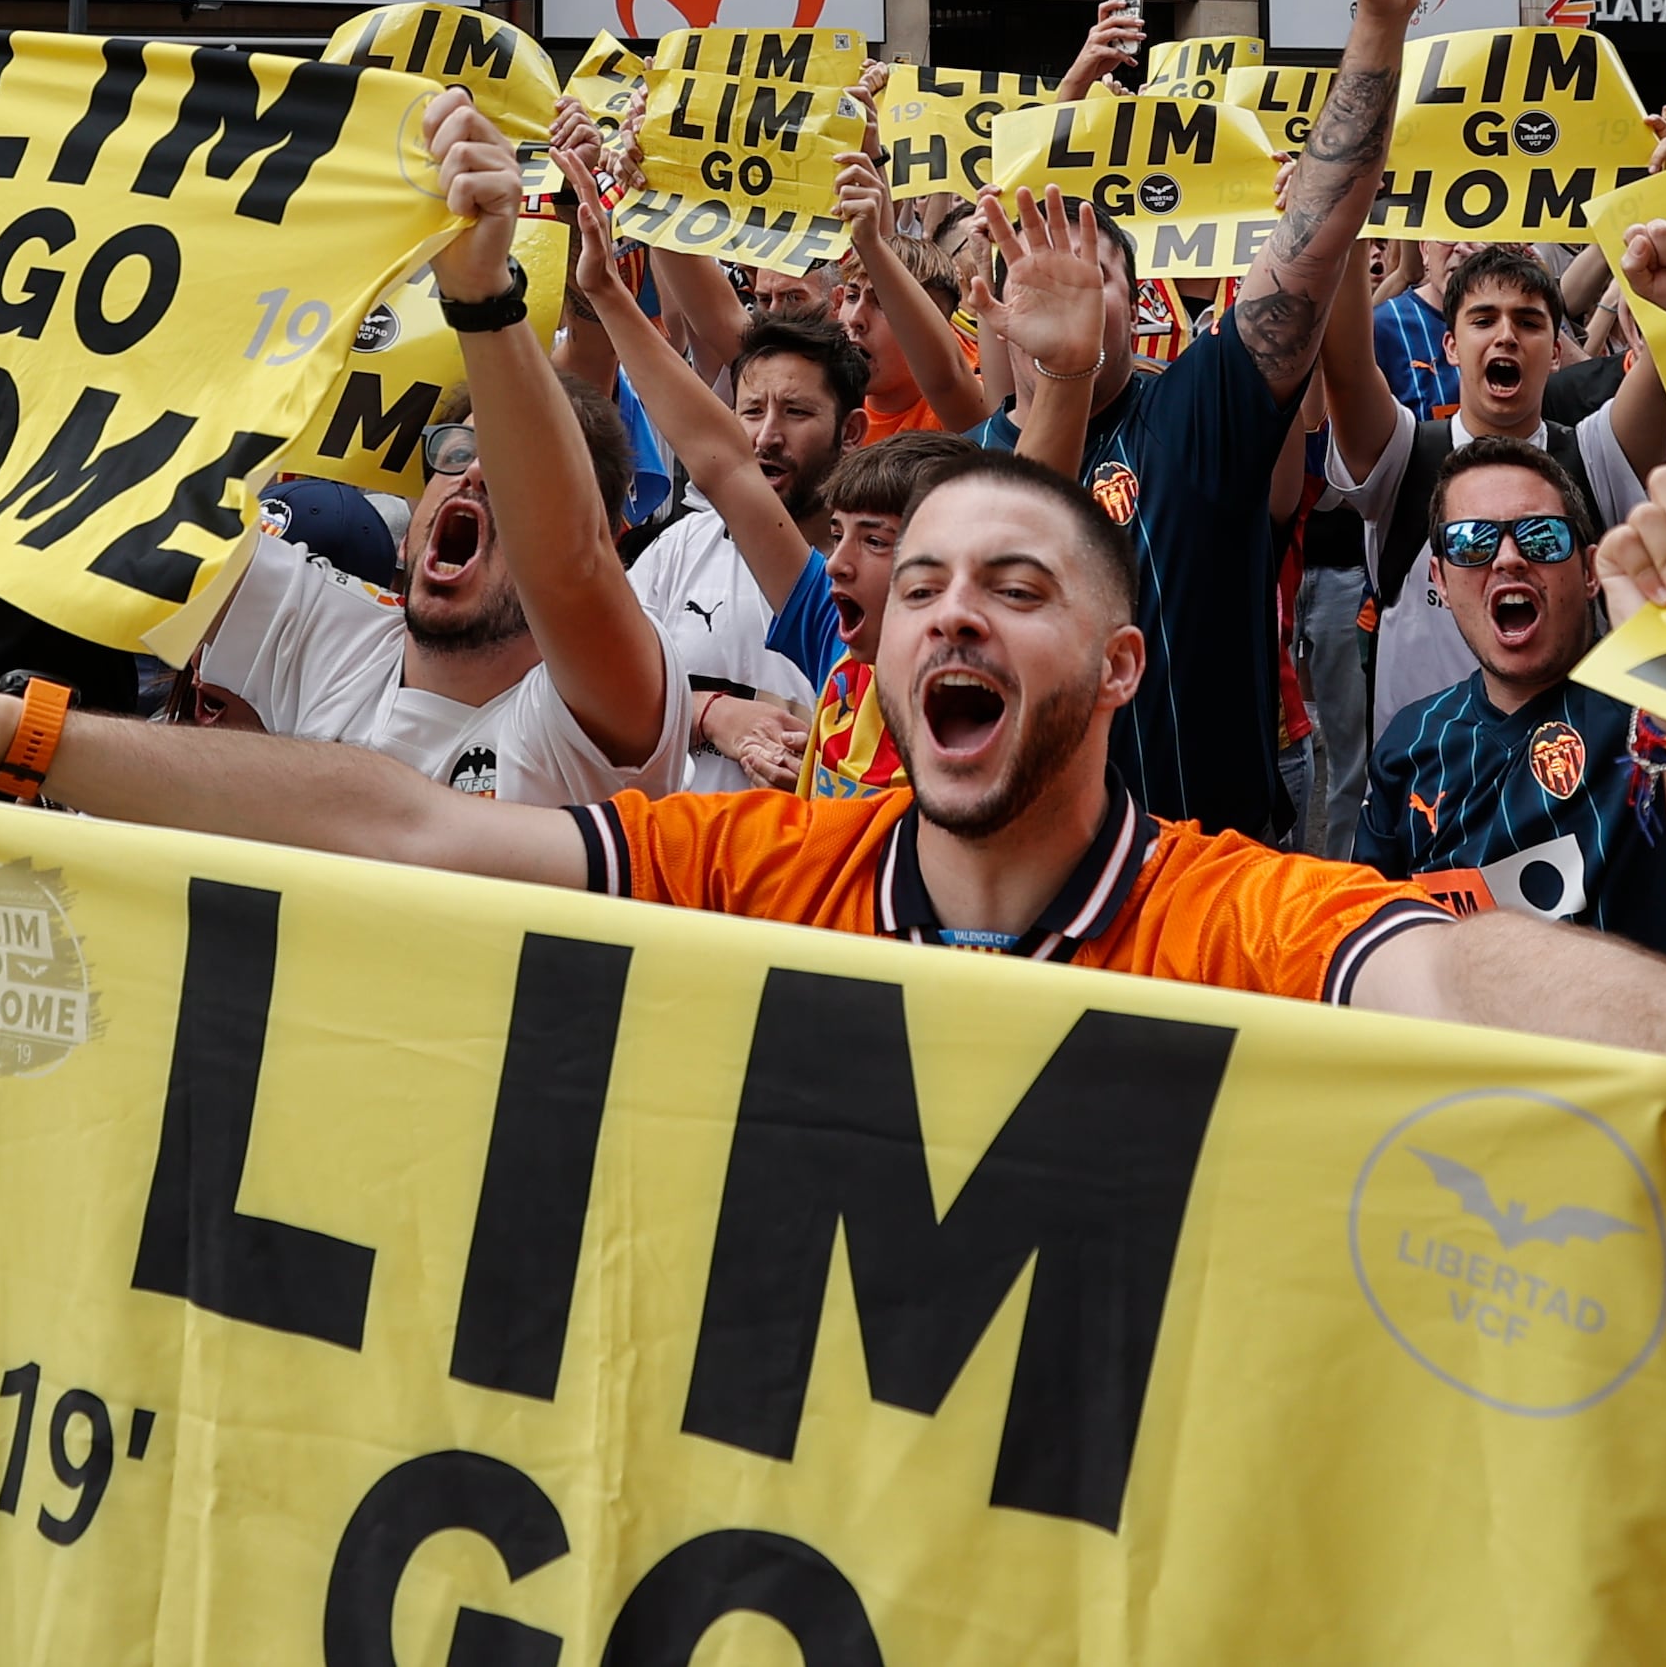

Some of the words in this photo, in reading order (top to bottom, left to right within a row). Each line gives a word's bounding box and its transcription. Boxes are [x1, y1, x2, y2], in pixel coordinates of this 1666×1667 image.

[353, 8, 519, 81] LIM
[1416, 33, 1598, 104] LIM
[669, 78, 816, 153] LIM
[889, 102, 929, 124] 19'
[1168, 80, 1216, 100] GO
[1258, 70, 1338, 112] LI
[1046, 103, 1218, 168] LIM
[1520, 133, 1552, 141] LIBERTAD
[700, 150, 773, 196] GO
[1145, 195, 1175, 203] LIBERTAD
[617, 189, 843, 269] HOME
[1151, 221, 1269, 270] ME
[954, 931, 993, 944] VALENCIA
[132, 878, 1237, 1534] LIM
[1397, 1230, 1608, 1335] LIBERTAD
[1449, 1290, 1530, 1348] VCF
